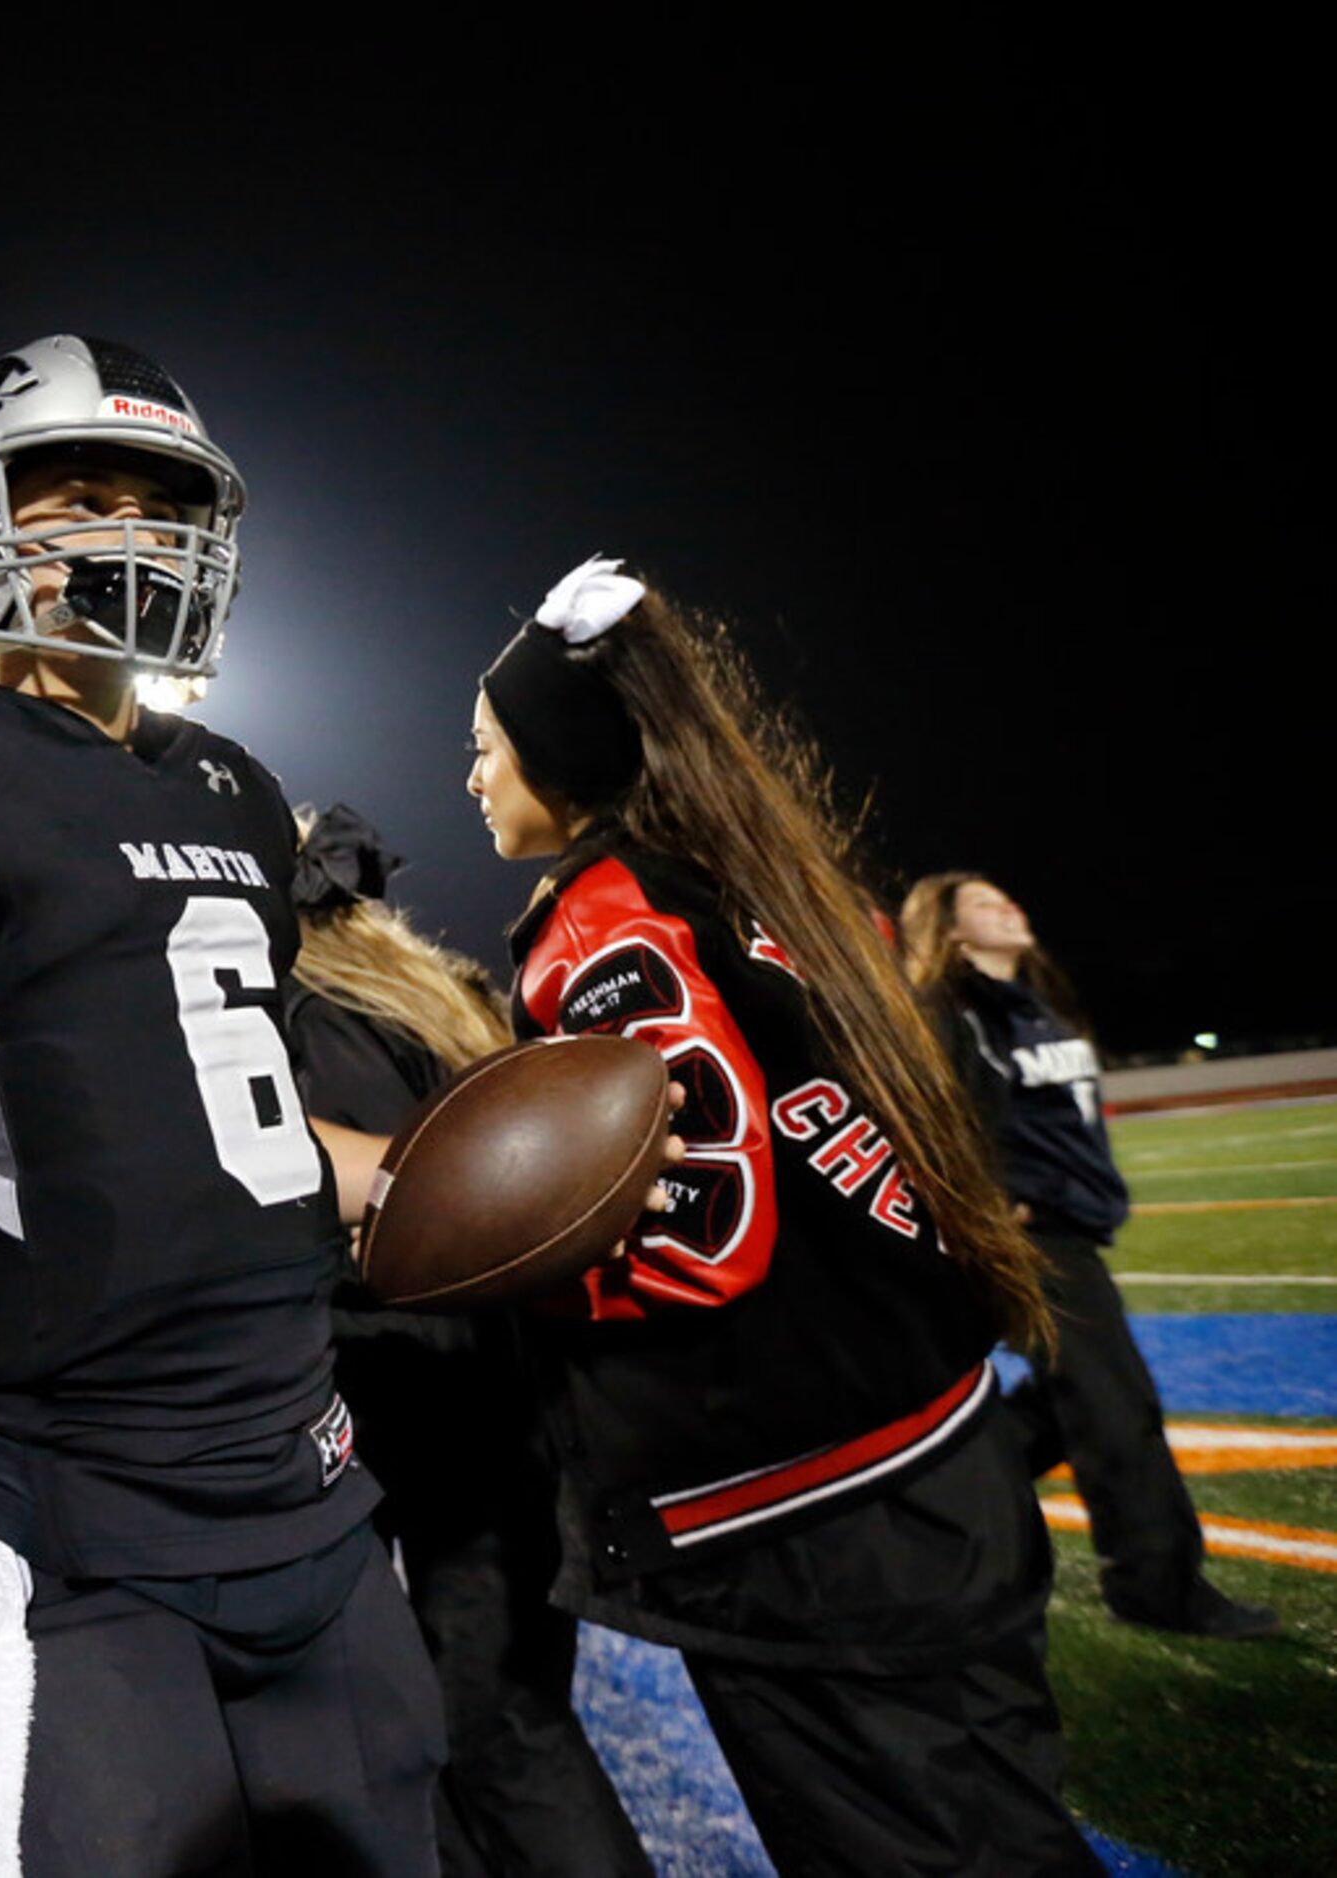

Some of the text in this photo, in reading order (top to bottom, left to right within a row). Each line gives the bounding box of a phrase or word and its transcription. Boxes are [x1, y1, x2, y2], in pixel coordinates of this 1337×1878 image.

[119, 842, 269, 888] MARTIN
[567, 970, 641, 1018] FRESHMAN
[166, 896, 322, 1206] 6
[771, 1078, 950, 1253] CHE
[657, 1177, 700, 1203] SITY
